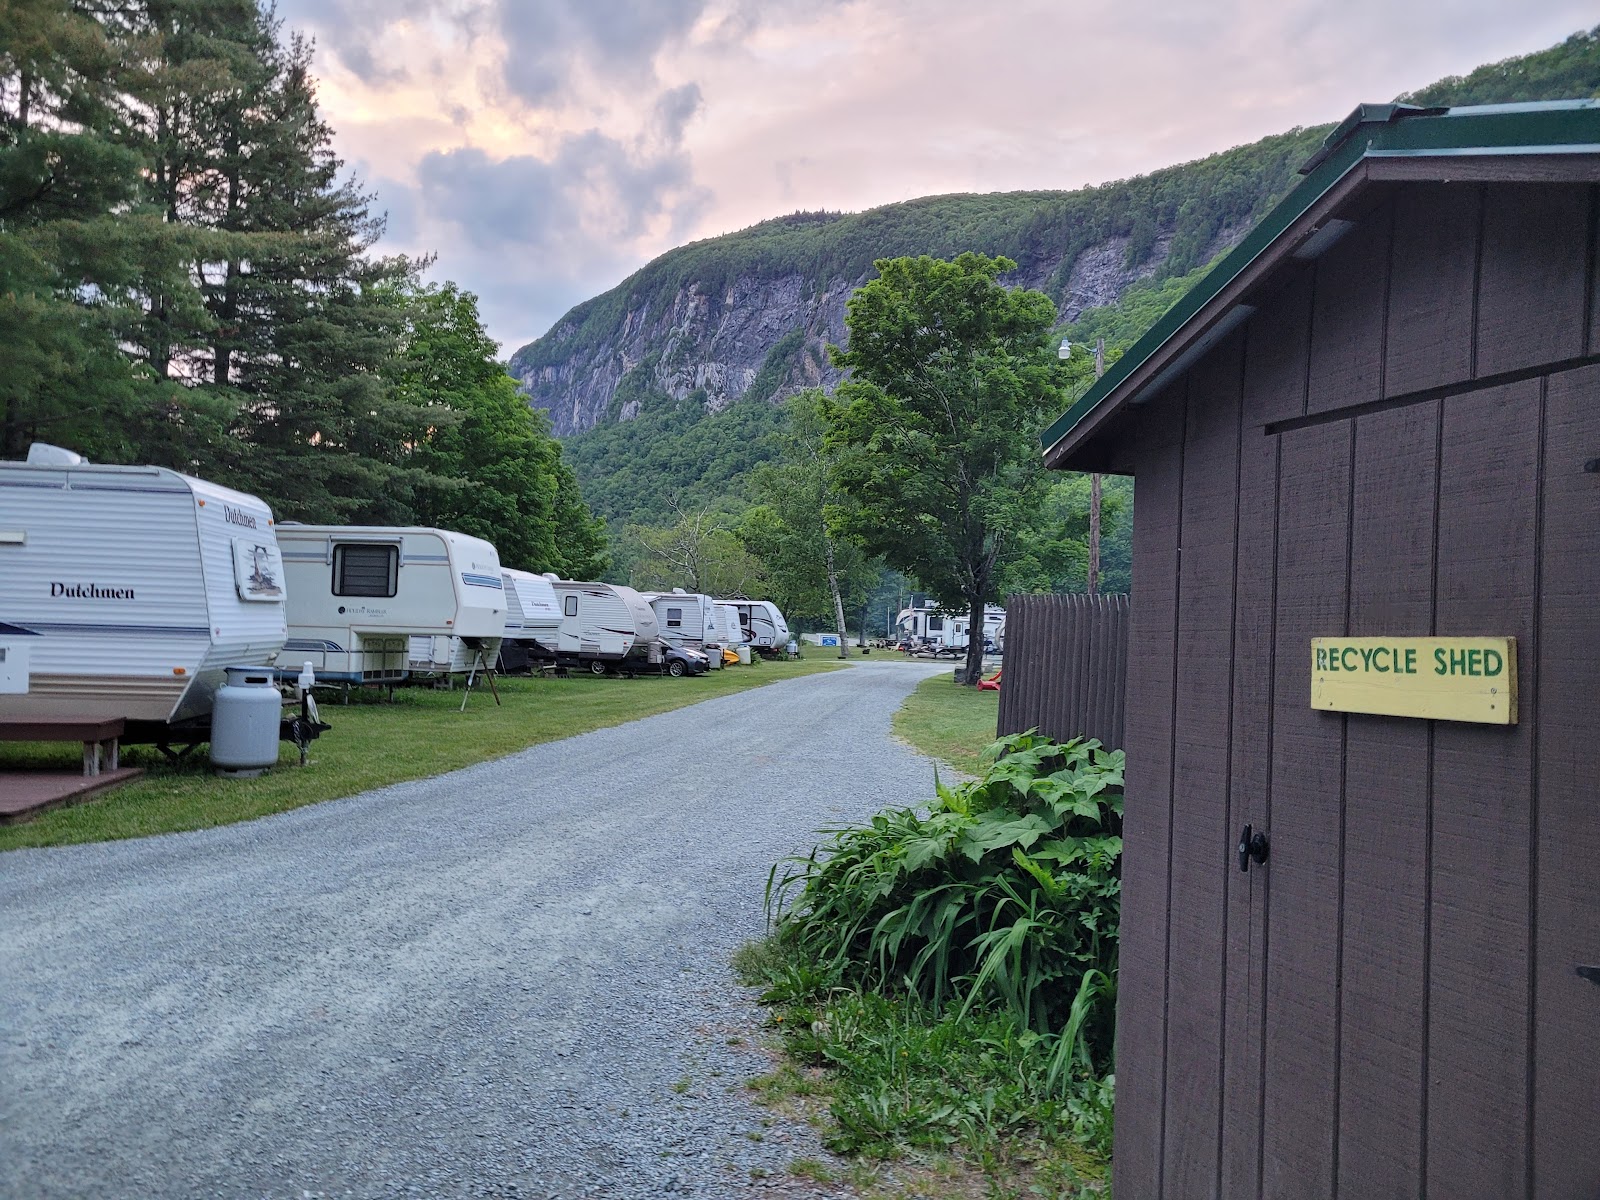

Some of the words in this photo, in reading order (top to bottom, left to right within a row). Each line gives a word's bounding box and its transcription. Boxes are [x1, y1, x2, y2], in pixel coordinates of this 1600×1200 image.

[224, 505, 258, 529] Dutchmen
[50, 582, 135, 600] Dutchmen
[1316, 646, 1417, 674] RECYCLE
[1434, 647, 1503, 677] SHED
